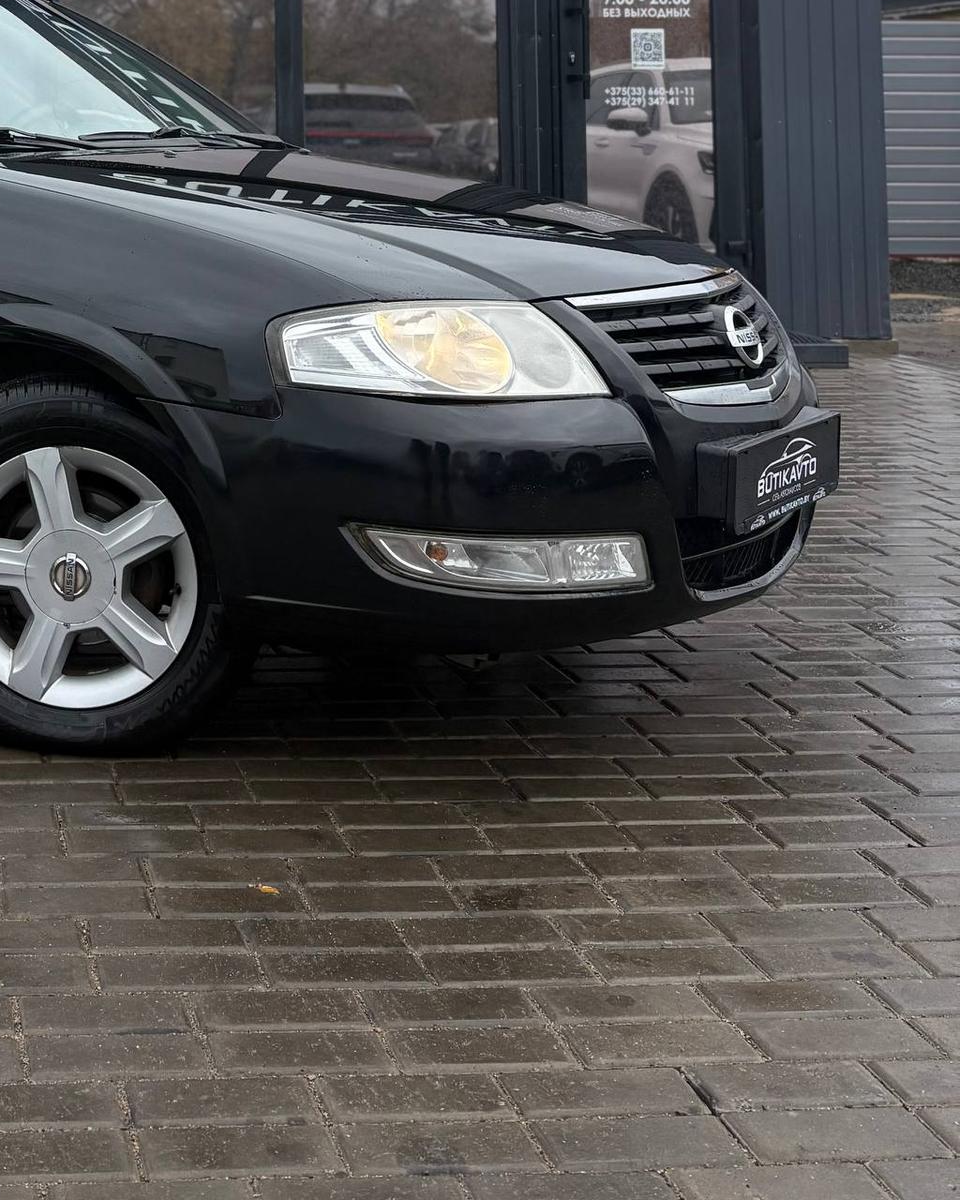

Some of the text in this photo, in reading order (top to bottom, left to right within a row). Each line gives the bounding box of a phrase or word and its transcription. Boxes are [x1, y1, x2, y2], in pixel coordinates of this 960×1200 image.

[602, 7, 690, 18] БЕЗ ВЫХОДНЫХ
[604, 86, 695, 98] +375(33) 660-61-11
[604, 97, 646, 108] +375(29)
[757, 456, 817, 499] BUTIKAVTO
[66, 558, 75, 596] NISSAN
